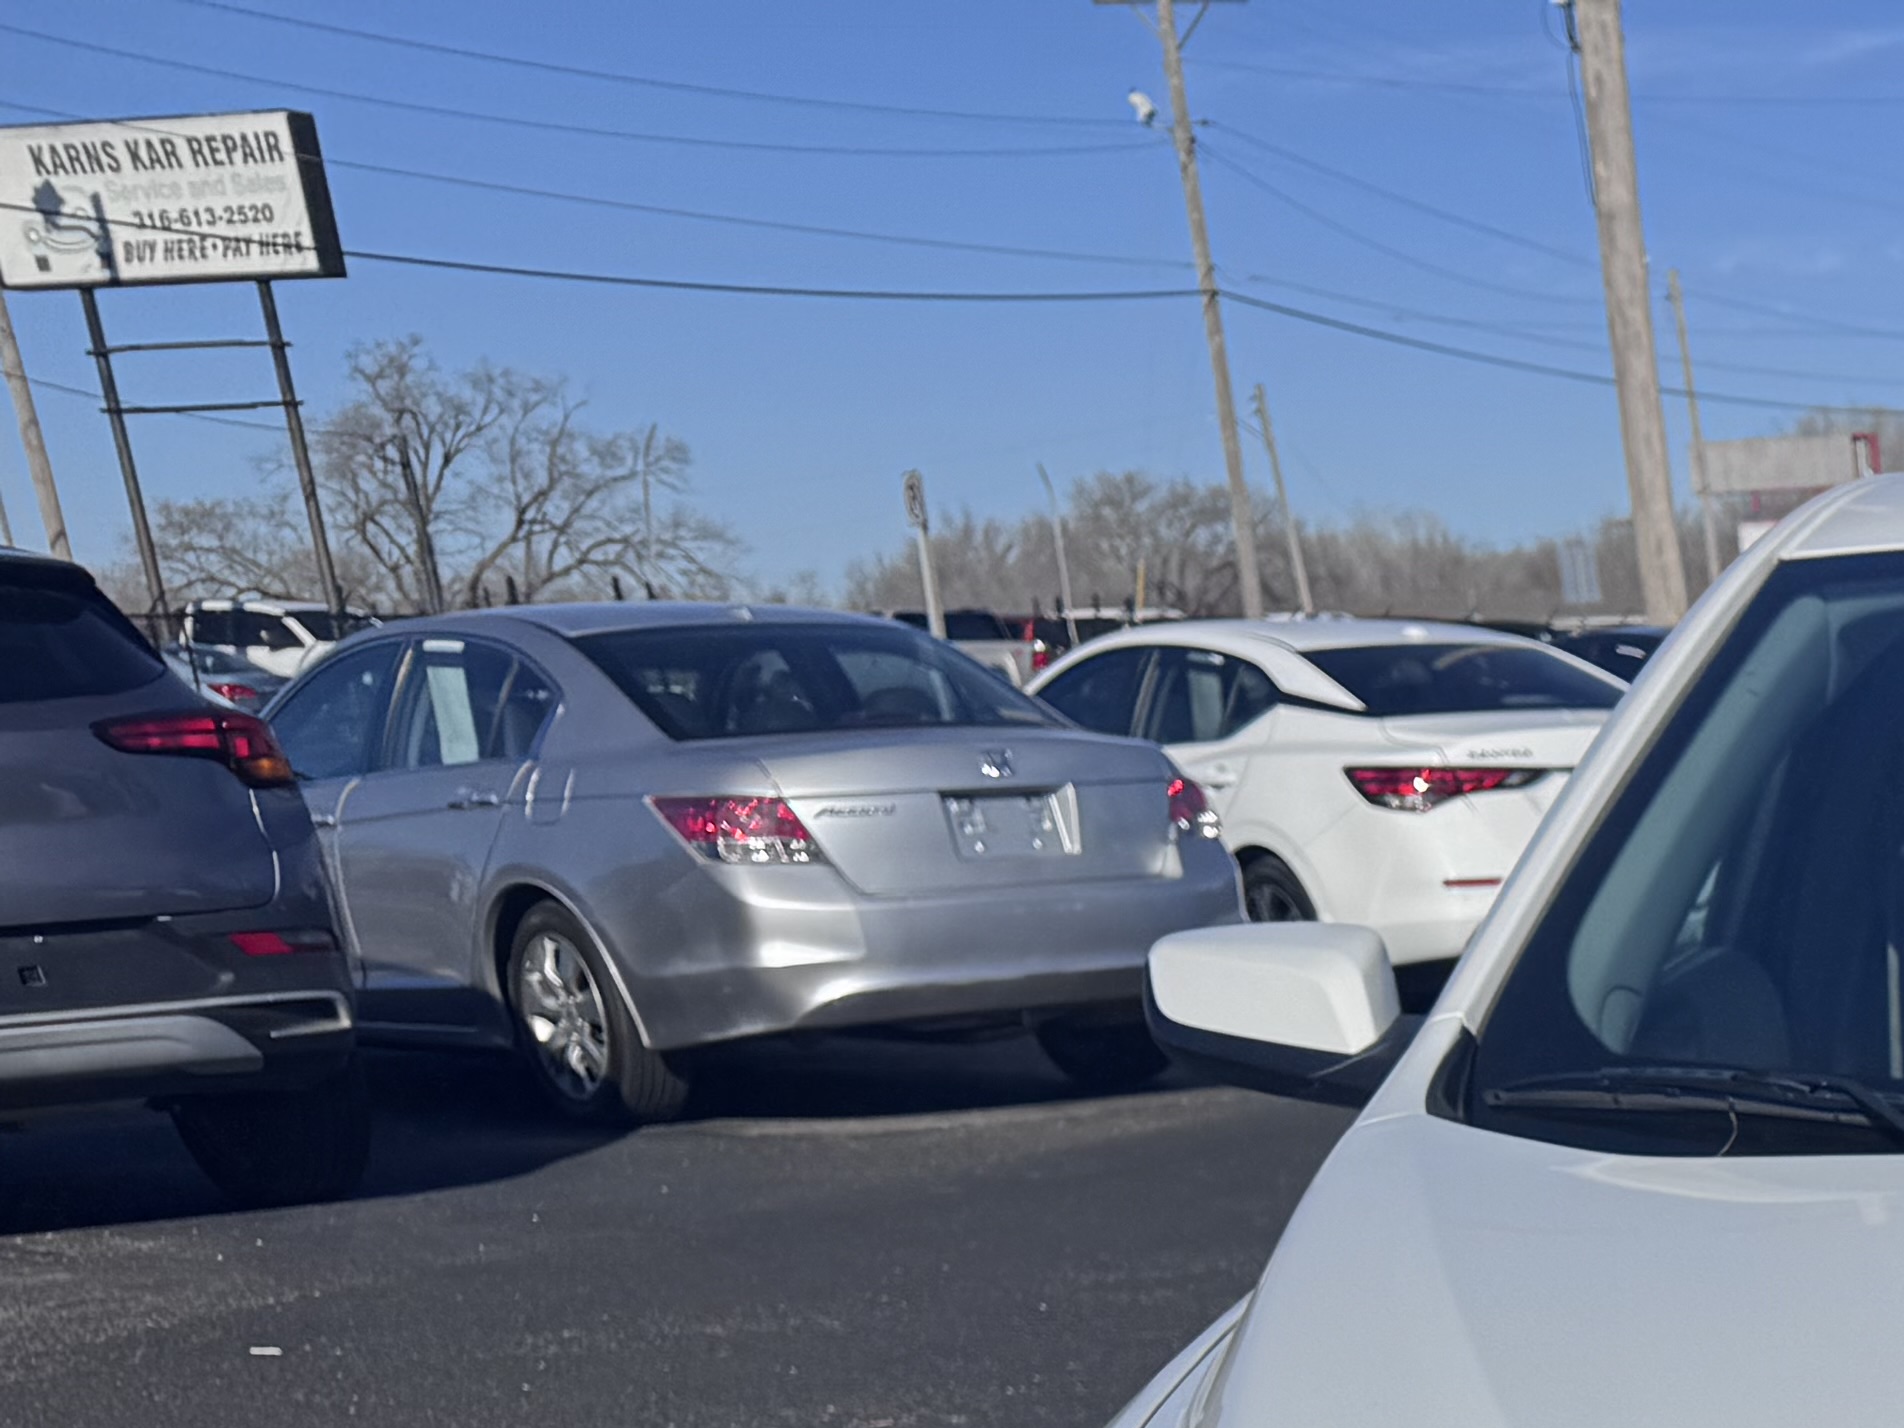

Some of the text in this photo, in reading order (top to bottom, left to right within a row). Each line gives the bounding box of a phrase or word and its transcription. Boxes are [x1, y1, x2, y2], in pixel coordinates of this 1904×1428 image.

[27, 129, 285, 176] KARNS KAR REPAIR
[132, 202, 274, 229] 316-613-2520
[123, 239, 157, 264] BUY
[163, 236, 209, 262] HERE
